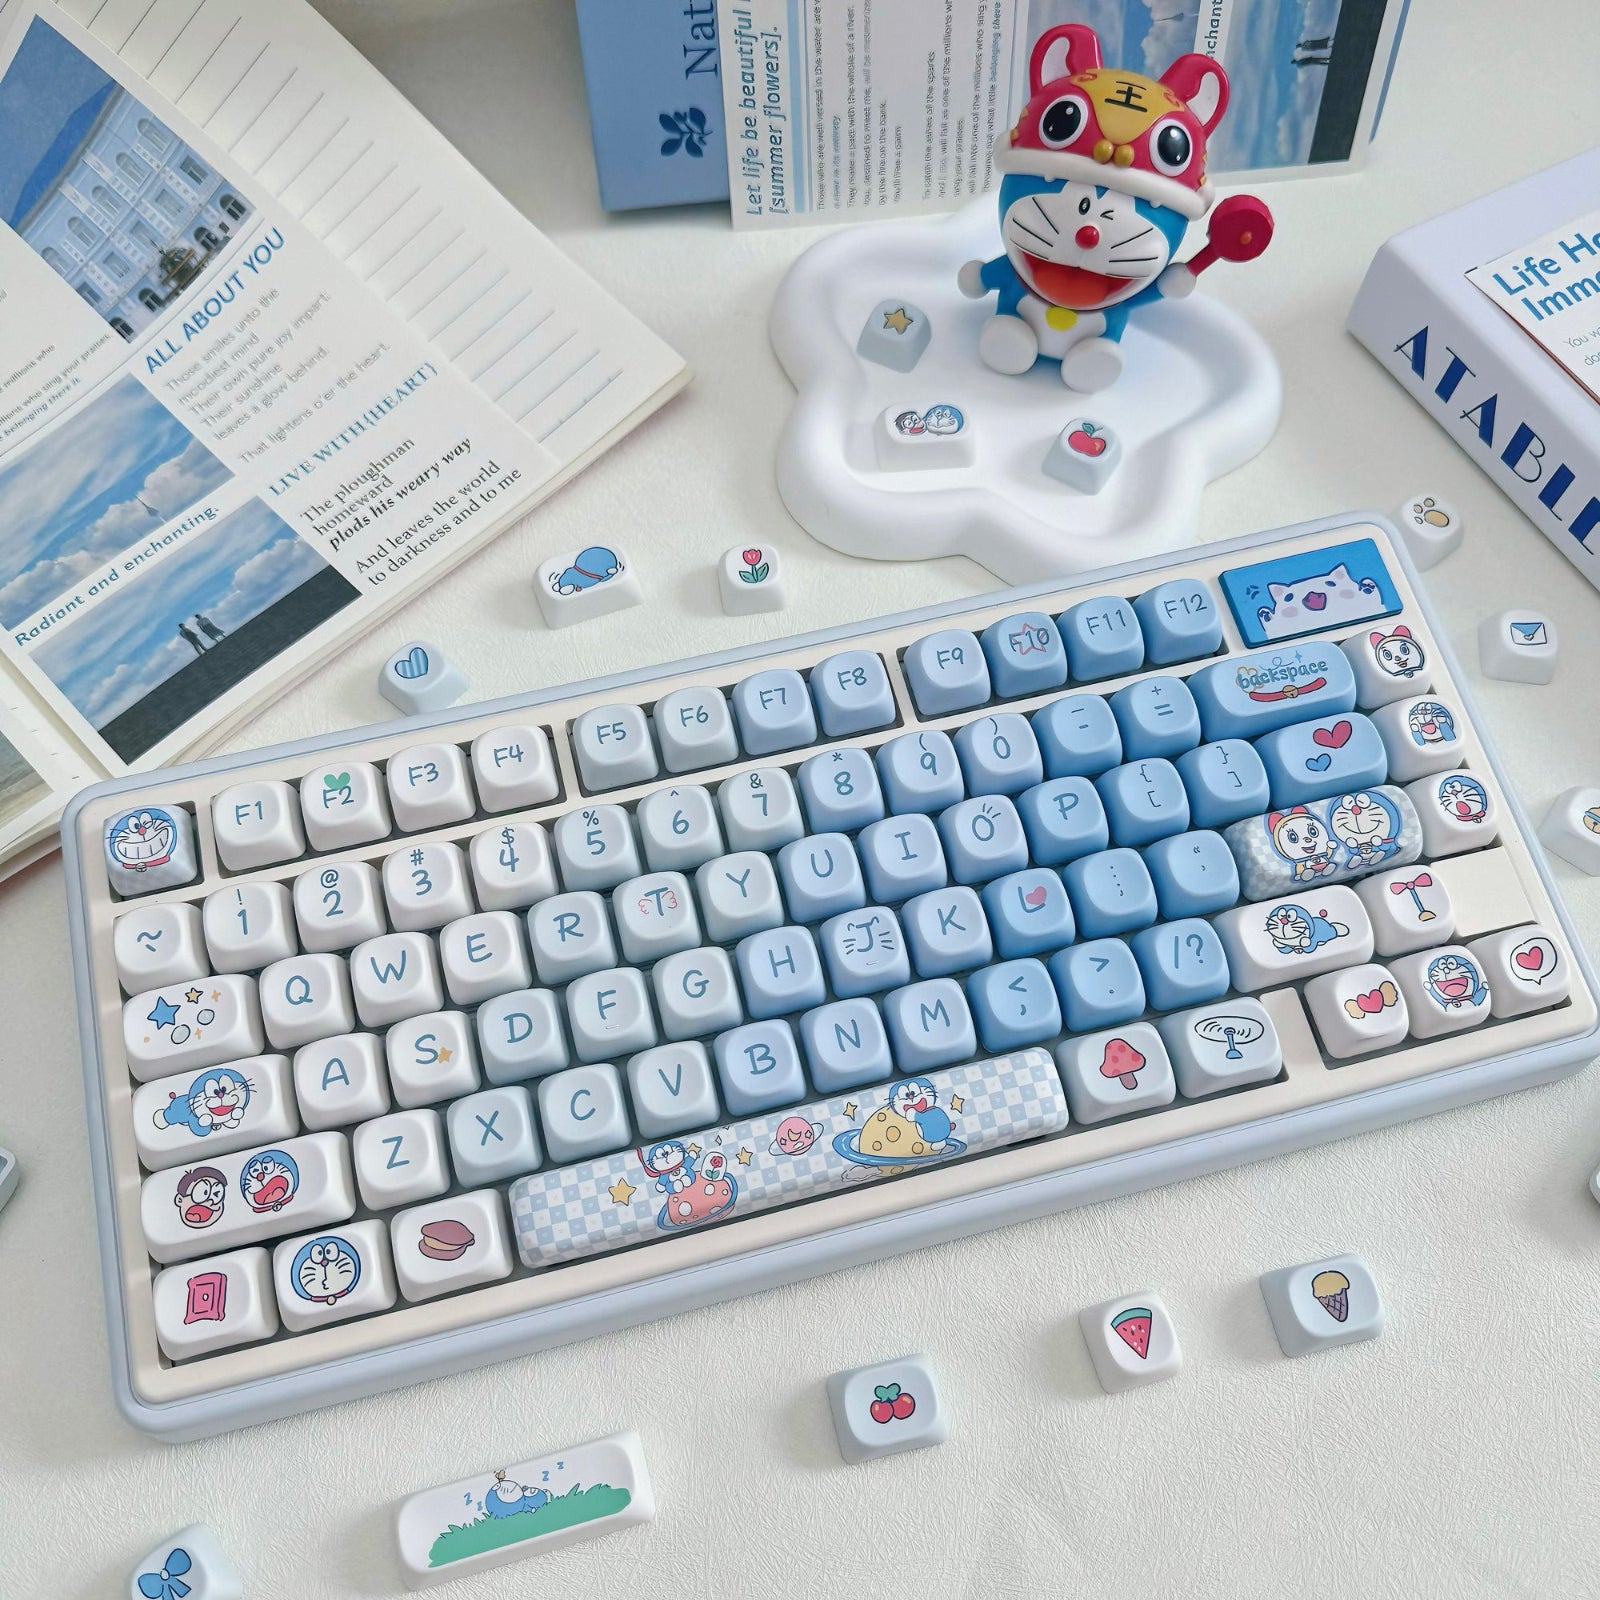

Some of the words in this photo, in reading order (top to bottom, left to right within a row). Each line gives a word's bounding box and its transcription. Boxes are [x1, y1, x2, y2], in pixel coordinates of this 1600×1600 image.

[732, 9, 758, 109] beautiful
[740, 117, 758, 140] be
[741, 147, 764, 179] life
[745, 184, 762, 215] Let
[1493, 256, 1562, 295] Life
[145, 339, 183, 374] ALL
[182, 271, 245, 342] ABOUT
[243, 227, 284, 274] YOU
[1563, 335, 1589, 348] You
[166, 362, 200, 392] Those
[202, 332, 235, 363] smiles
[240, 440, 270, 464] That
[267, 408, 314, 443] lightens
[335, 369, 358, 390] the
[268, 461, 316, 497] LIVE
[334, 439, 416, 500] ploughman
[312, 474, 394, 537] homeward
[329, 513, 372, 552] plods
[371, 497, 396, 520] his
[395, 463, 440, 501] weary
[442, 437, 472, 466] way
[355, 543, 391, 575] And
[386, 513, 434, 549] leaves
[432, 495, 457, 518] the
[457, 459, 501, 498] world
[368, 569, 388, 587] to
[388, 523, 453, 574] darkness
[452, 499, 482, 526] and
[480, 487, 498, 503] to
[498, 468, 522, 491] me
[14, 595, 86, 647] Radiant
[88, 568, 120, 596] and
[1163, 593, 1208, 619] F12
[1086, 609, 1127, 635] F11
[1008, 627, 1050, 652] F10
[936, 647, 964, 670] F9
[837, 667, 867, 690] F8
[1238, 660, 1329, 689] backspace
[759, 688, 787, 710] F7
[680, 705, 709, 727] F6
[597, 722, 627, 745] F5
[993, 735, 1011, 760] 0
[493, 744, 524, 767] F4
[920, 751, 938, 776] 9
[408, 762, 439, 787] F3
[834, 771, 854, 796] 8
[322, 786, 355, 809] F2
[752, 793, 768, 817] 7
[1052, 792, 1080, 820] P
[235, 800, 263, 826] F1
[672, 810, 690, 835] 6
[971, 814, 995, 842] O
[586, 830, 606, 855] 5
[894, 831, 918, 861] I
[499, 847, 519, 873] 4
[810, 849, 834, 878] U
[413, 869, 433, 896] 3
[726, 868, 751, 898] Y
[323, 891, 344, 917] 2
[644, 886, 669, 916] T
[1017, 885, 1047, 913] L
[237, 909, 249, 935] 1
[553, 912, 584, 941] R
[937, 904, 966, 936] K
[466, 933, 493, 963] E
[855, 922, 874, 953] J
[370, 950, 407, 984] W
[768, 945, 796, 978] H
[285, 975, 313, 1006] Q
[682, 969, 710, 999] G
[597, 989, 617, 1020] F
[920, 998, 951, 1033] M
[503, 1012, 533, 1044] D
[834, 1019, 861, 1052] N
[414, 1034, 439, 1065] S
[744, 1043, 777, 1075] B
[322, 1057, 350, 1091] A
[658, 1063, 682, 1097] V
[570, 1089, 596, 1121] C
[475, 1110, 504, 1146] X
[382, 1136, 410, 1169] Z
